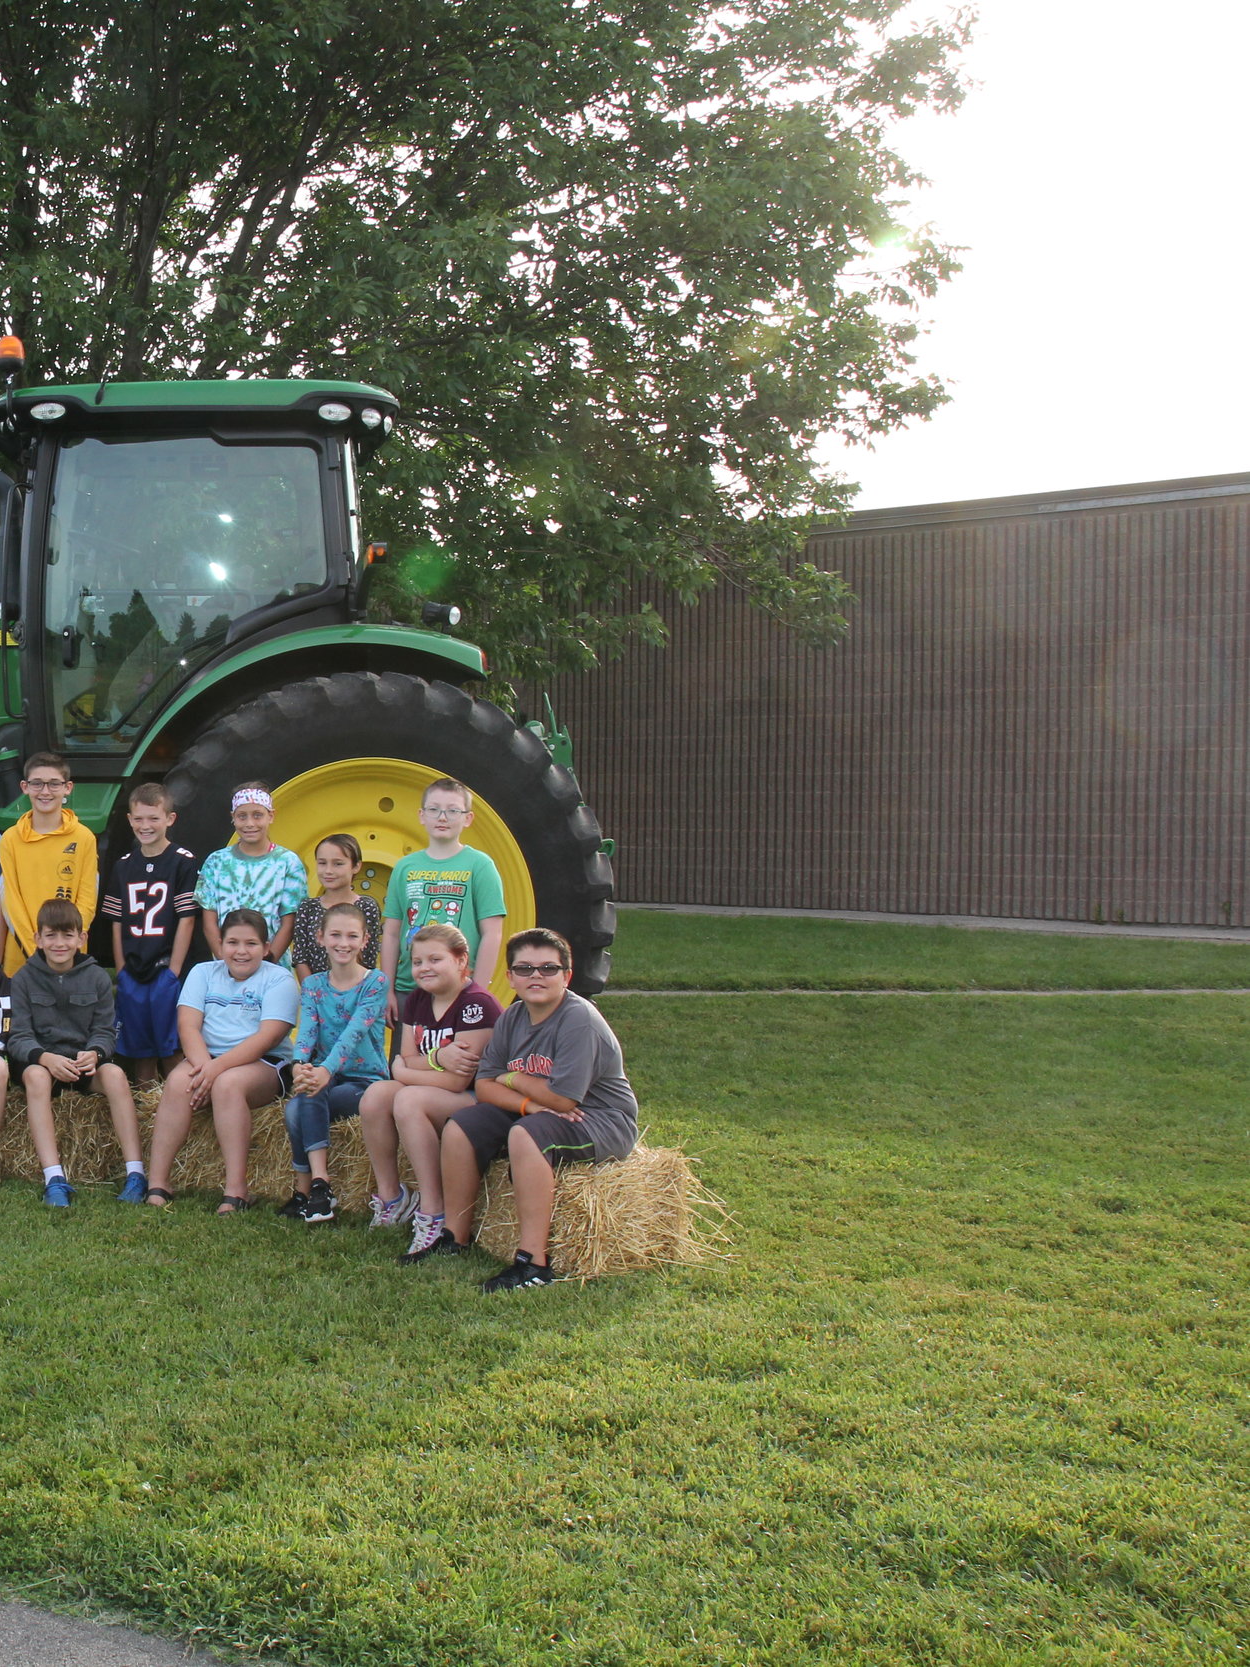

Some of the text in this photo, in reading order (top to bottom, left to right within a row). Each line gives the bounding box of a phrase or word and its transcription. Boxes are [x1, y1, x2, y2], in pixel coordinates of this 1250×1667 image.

[406, 870, 472, 882] SUPER MARIO
[427, 885, 464, 895] AWESOME
[127, 881, 169, 937] 52
[462, 1006, 483, 1017] LOVE
